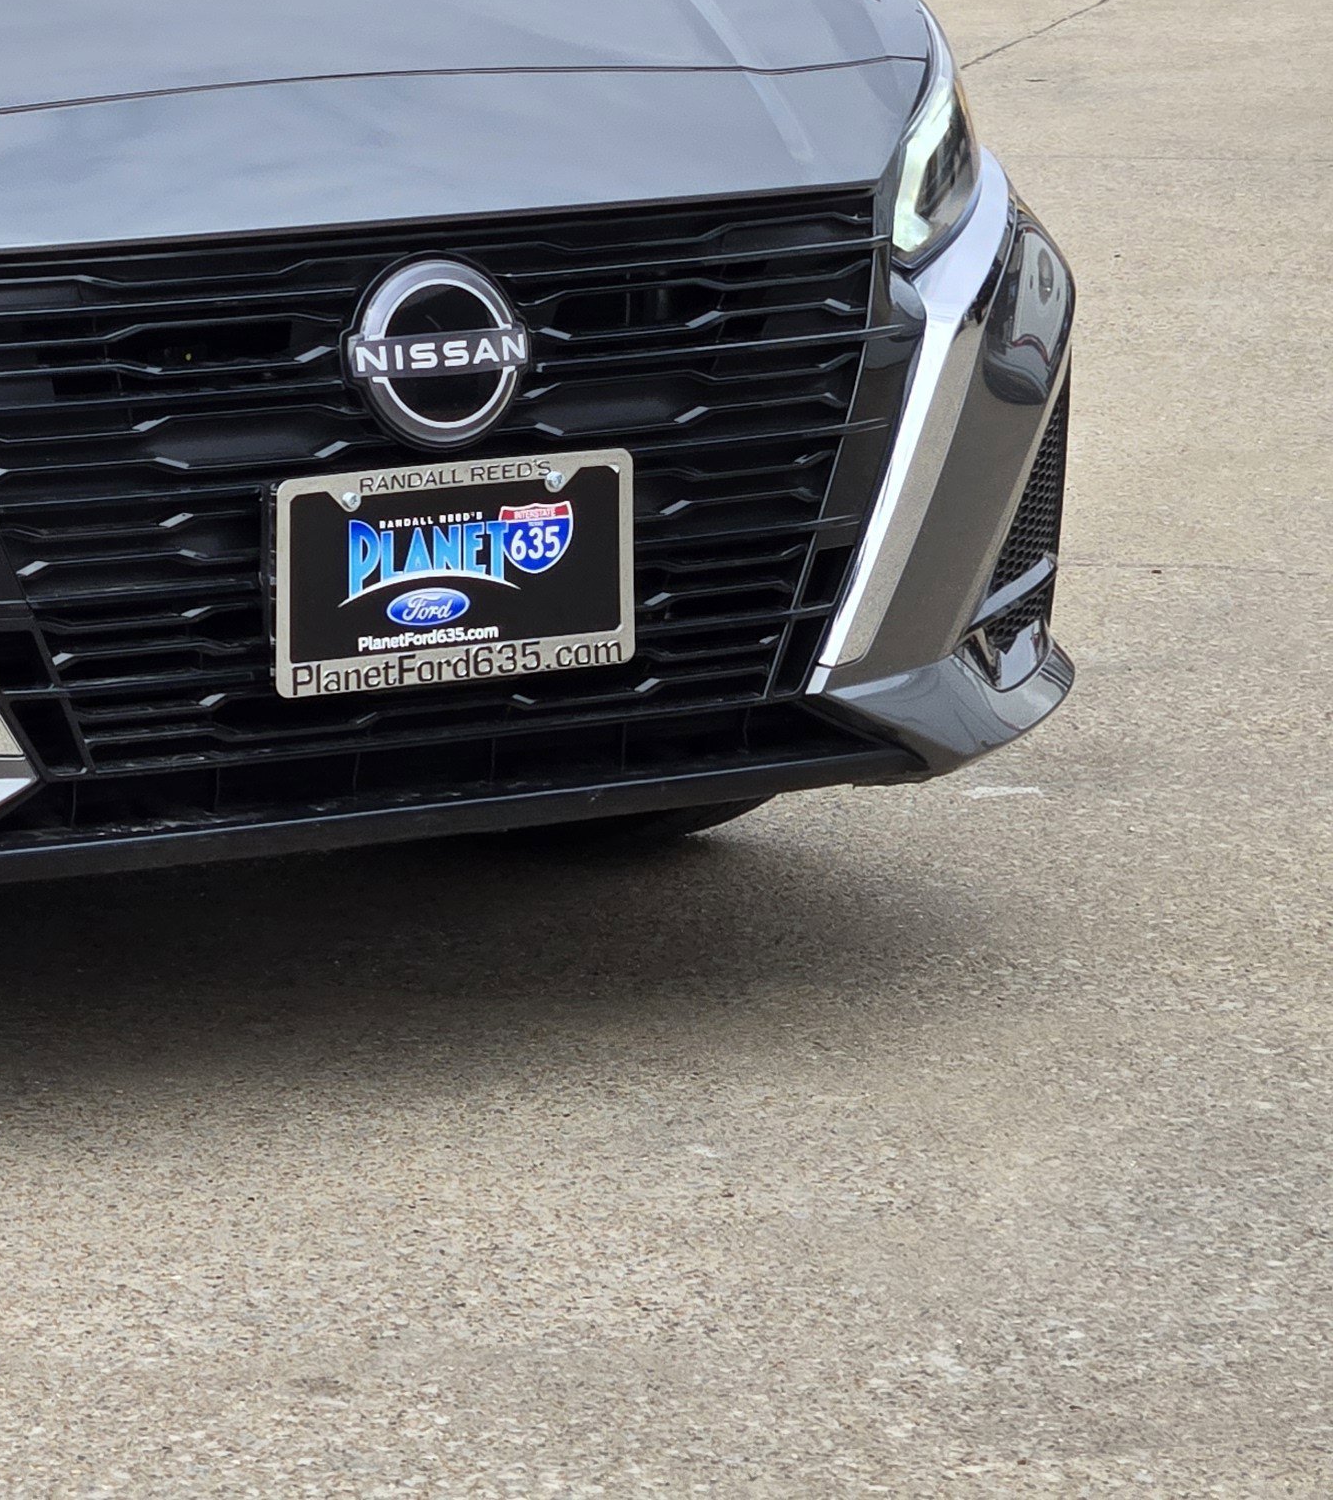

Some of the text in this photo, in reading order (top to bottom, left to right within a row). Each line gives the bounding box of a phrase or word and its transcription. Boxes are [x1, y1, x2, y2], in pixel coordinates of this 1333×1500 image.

[355, 332, 527, 375] NISSAN
[359, 459, 554, 494] RANDALL REED'S
[379, 515, 434, 530] RANDALL
[348, 520, 510, 600] PLANET
[510, 525, 562, 562] 635
[402, 596, 453, 621] Ford
[358, 626, 499, 652] PlanetFord635.com
[291, 638, 624, 697] PlanetFord635.com
